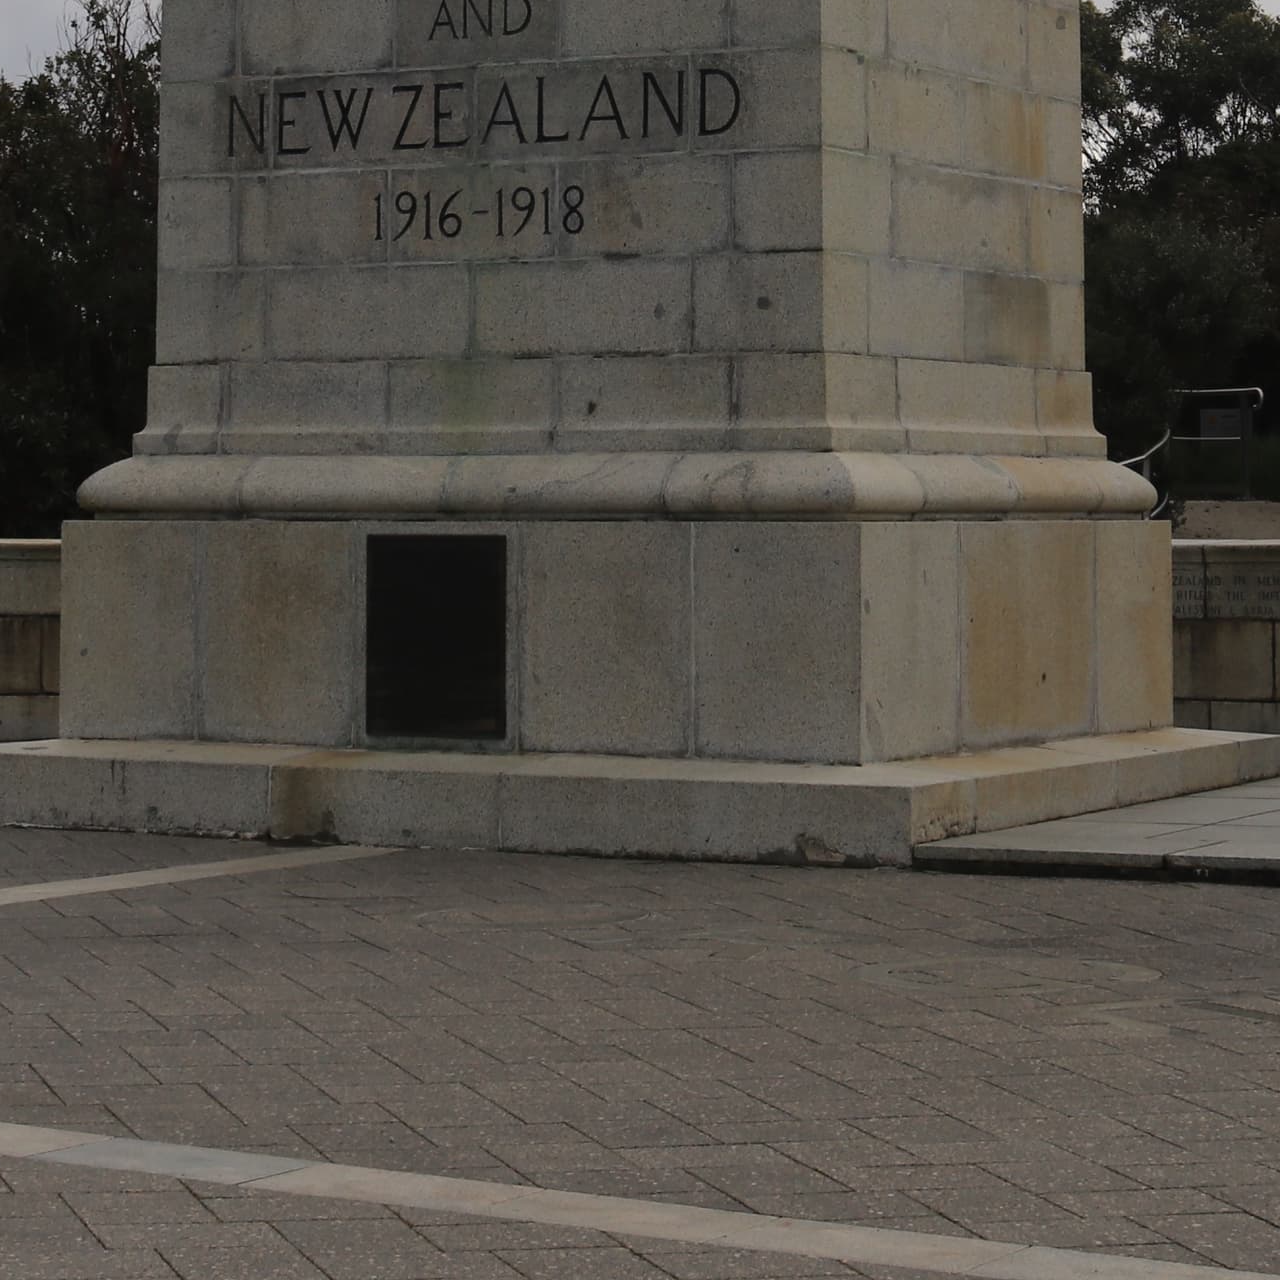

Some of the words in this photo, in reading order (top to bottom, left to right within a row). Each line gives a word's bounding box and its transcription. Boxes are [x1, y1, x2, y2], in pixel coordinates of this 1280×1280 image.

[226, 87, 375, 158] NEW
[391, 68, 741, 151] ZEALAND
[374, 184, 585, 243] 1916-1918
